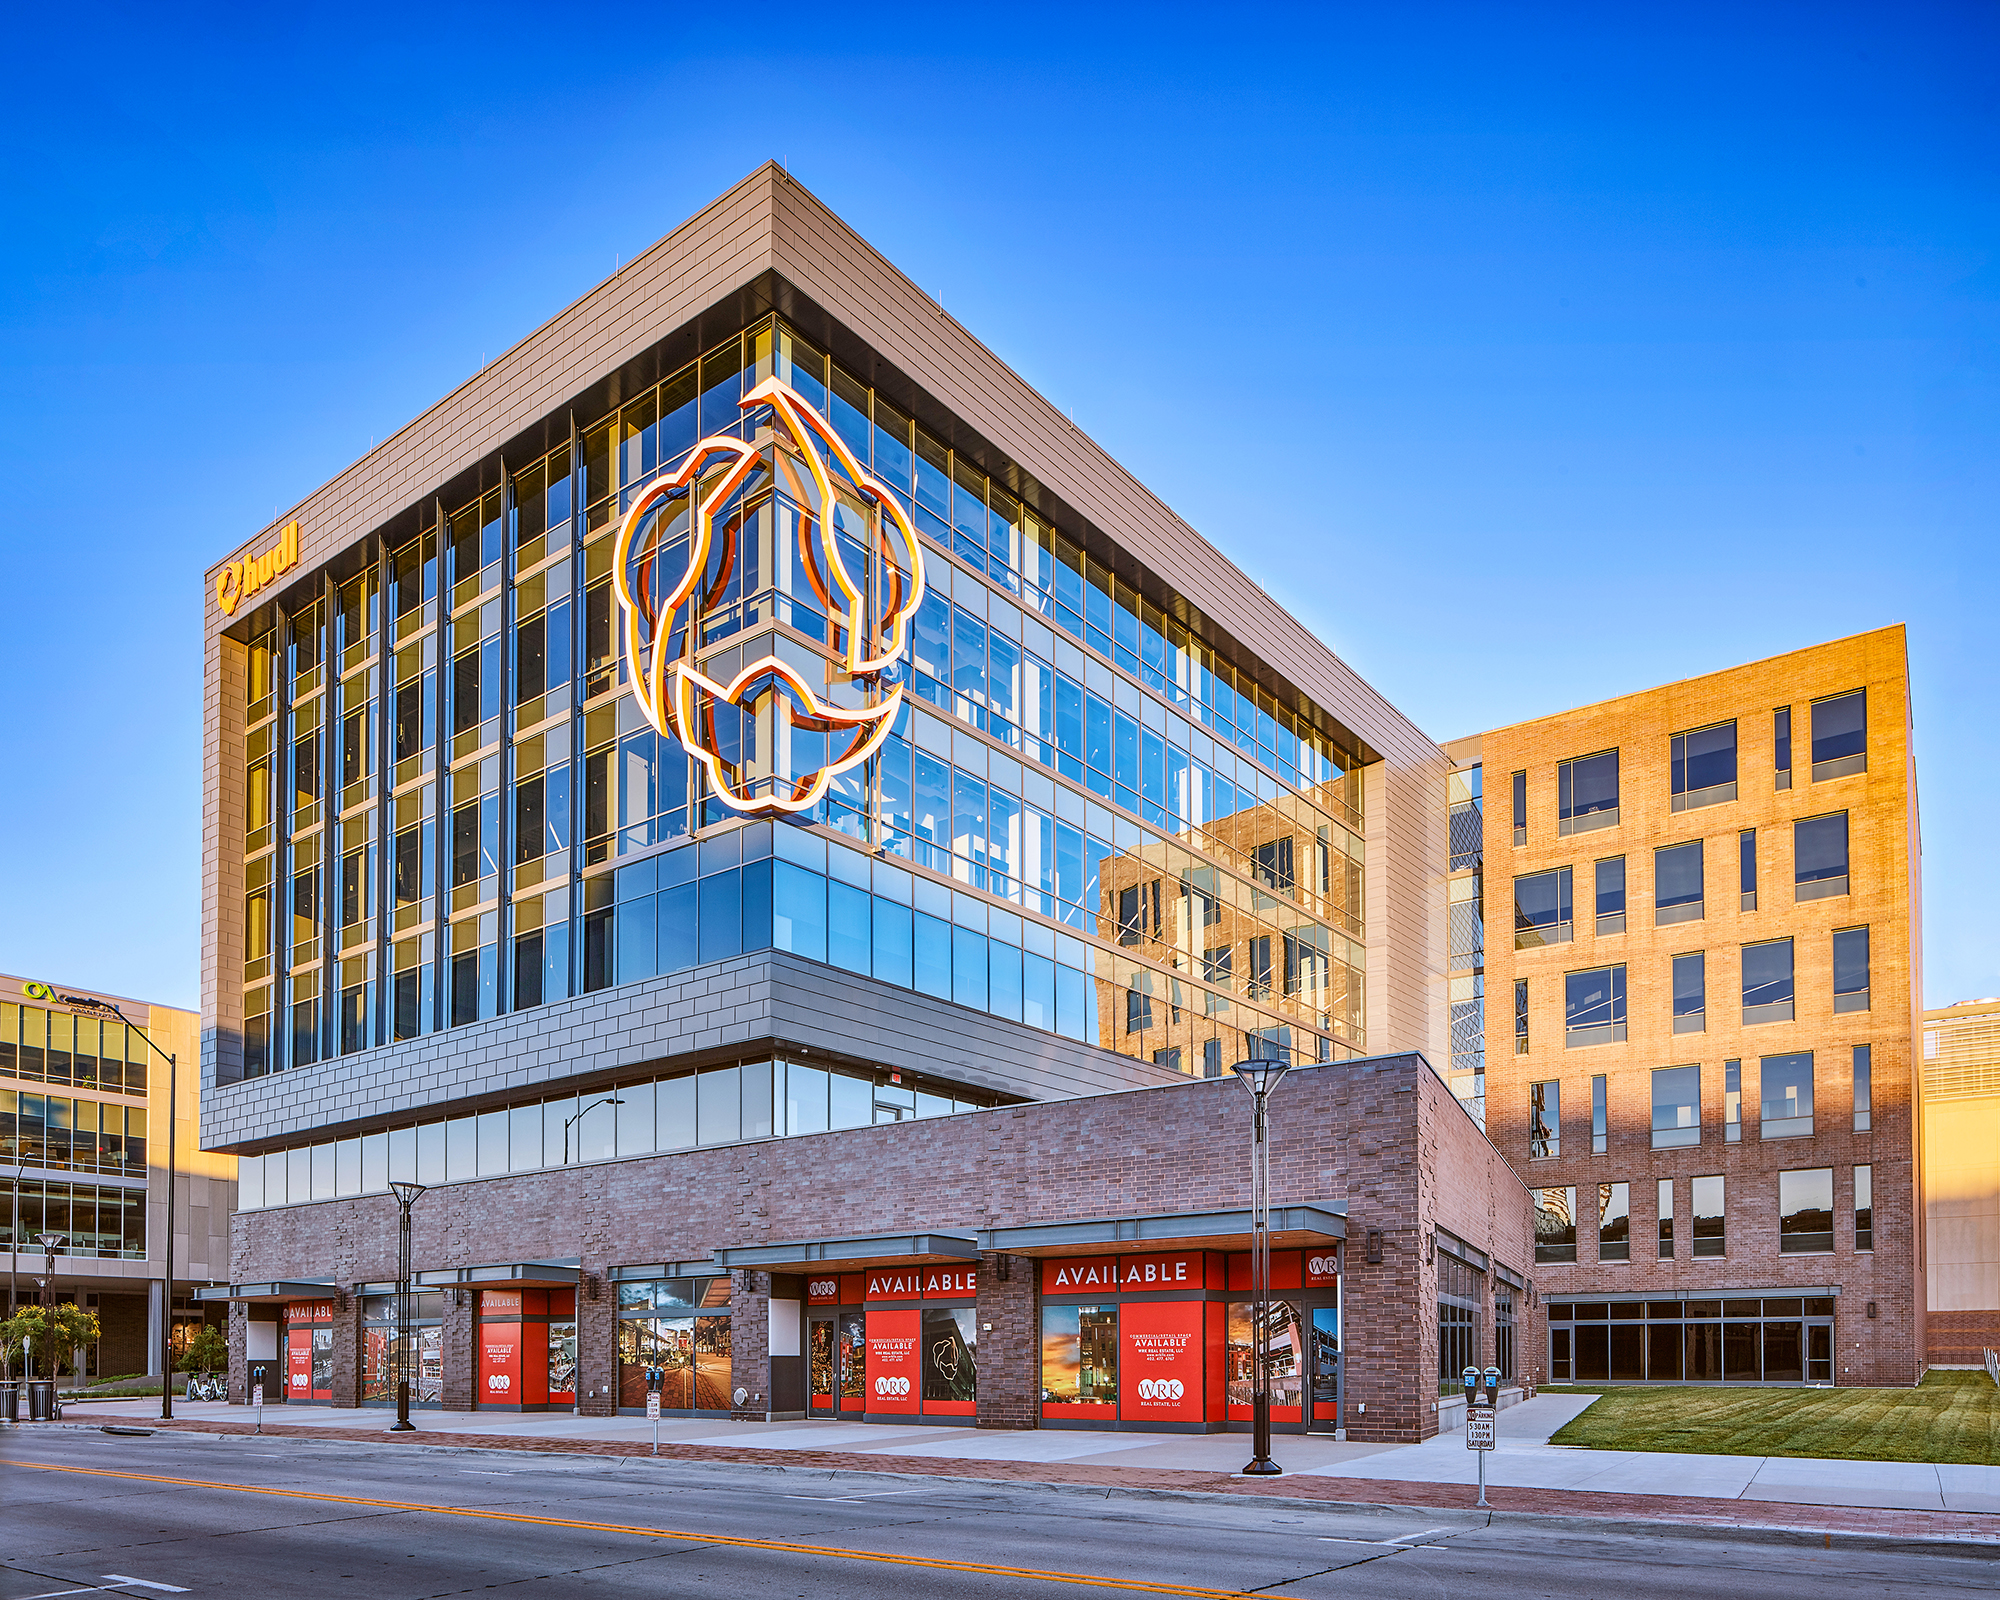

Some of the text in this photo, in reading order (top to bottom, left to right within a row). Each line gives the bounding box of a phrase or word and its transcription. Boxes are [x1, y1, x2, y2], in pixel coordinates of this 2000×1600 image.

[244, 520, 298, 597] hudl
[1310, 1259, 1337, 1273] WR
[1055, 1262, 1187, 1286] AVAILABLE
[810, 1282, 835, 1295] WRK
[868, 1273, 976, 1294] AVAILABLE
[481, 1298, 519, 1308] AVAILABLE
[289, 1305, 332, 1319] AVAILABL
[873, 1342, 913, 1350] AVAILABLE
[1135, 1339, 1187, 1347] AVAILABLE
[490, 1377, 509, 1389] WRK
[876, 1380, 908, 1394] WRK
[1139, 1383, 1181, 1398] WRK
[1468, 1440, 1494, 1448] SATURDAY
